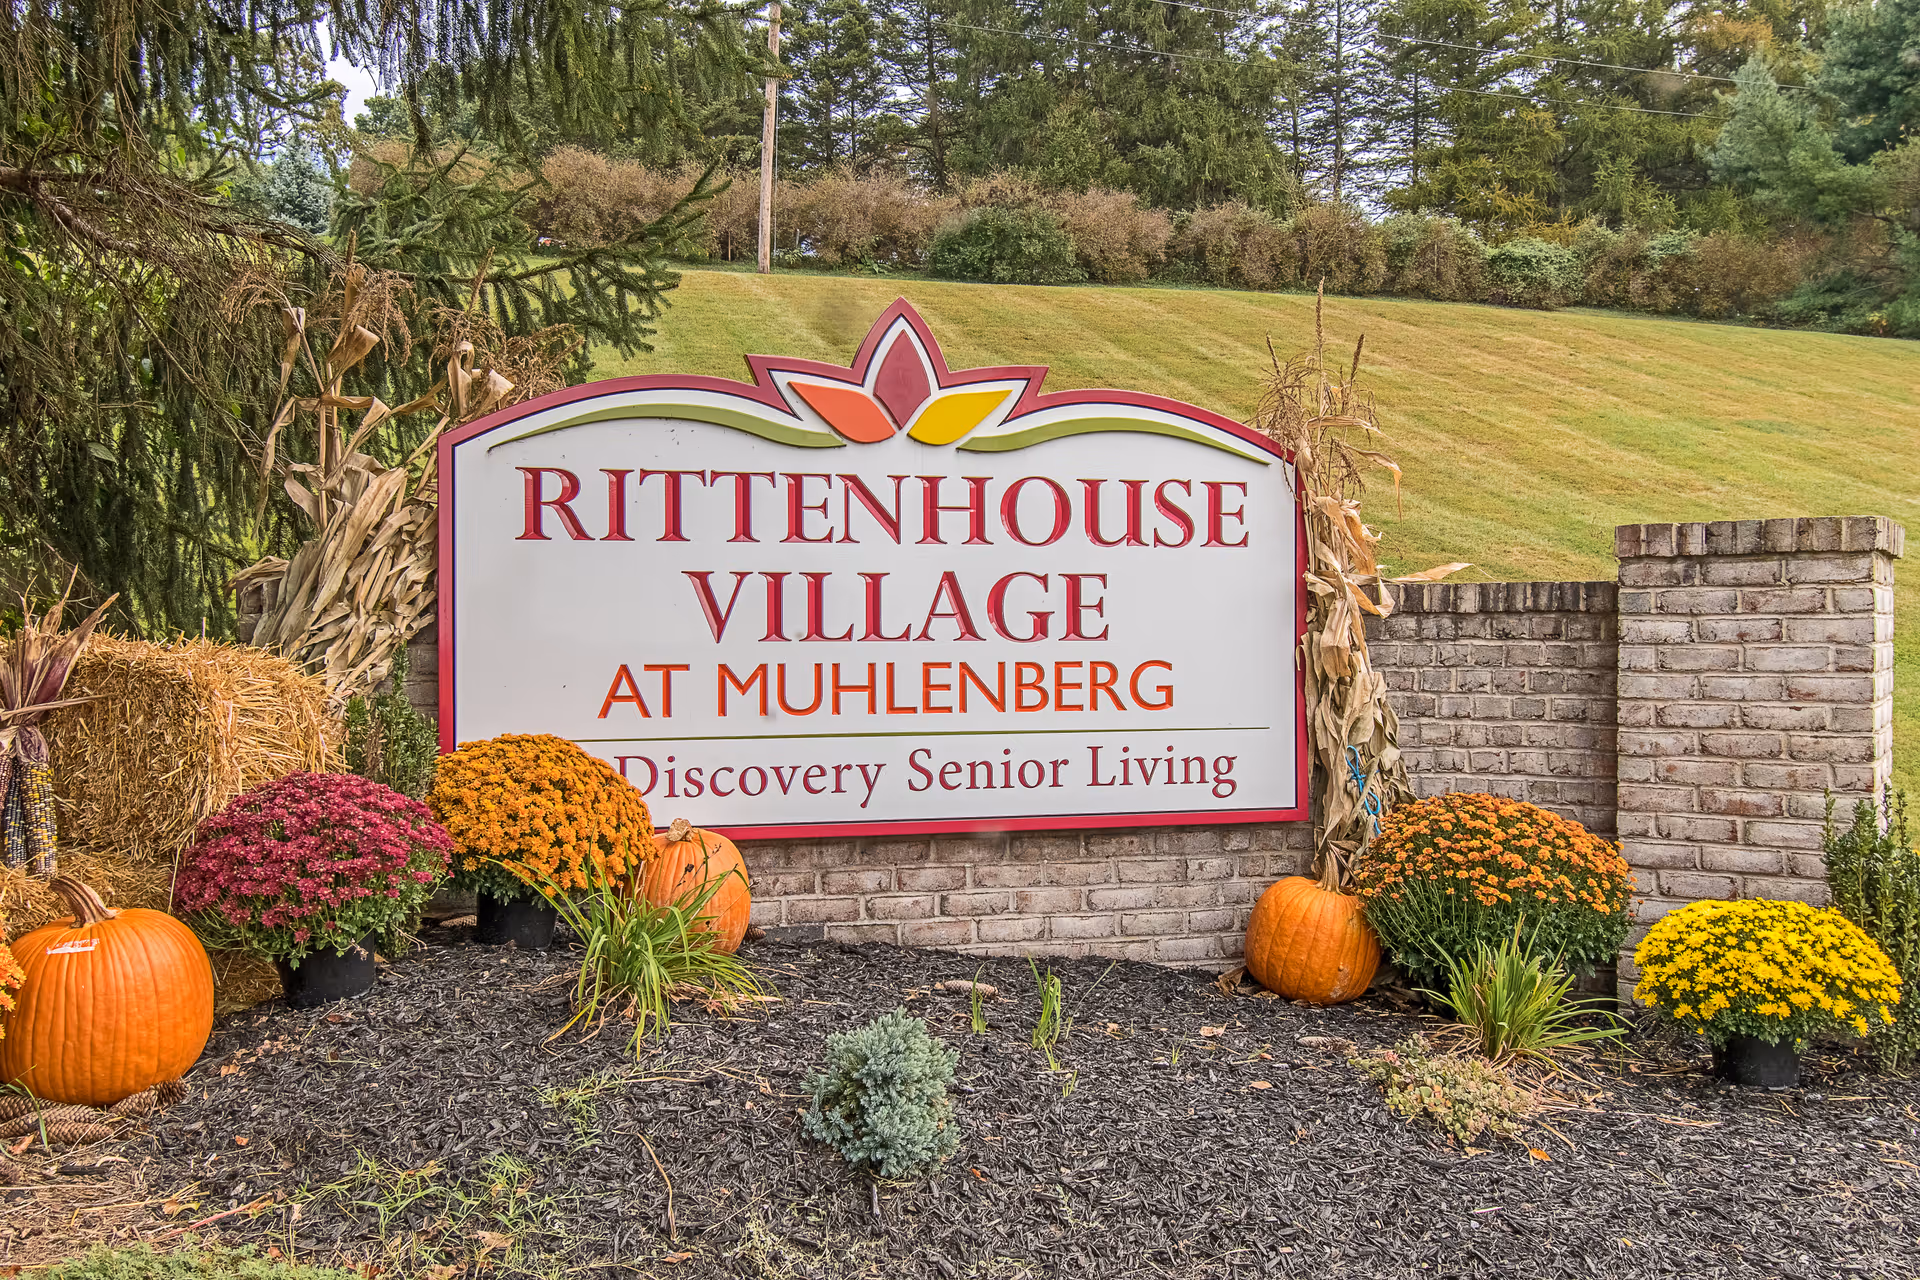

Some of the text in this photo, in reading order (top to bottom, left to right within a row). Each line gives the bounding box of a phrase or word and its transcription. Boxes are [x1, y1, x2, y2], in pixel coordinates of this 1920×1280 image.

[514, 466, 1249, 548] RITTENHOUSE
[681, 571, 1109, 643] VILLAGE
[598, 660, 1174, 719] AT MUHLENBERG
[613, 745, 1238, 809] Discovery Senior Living
